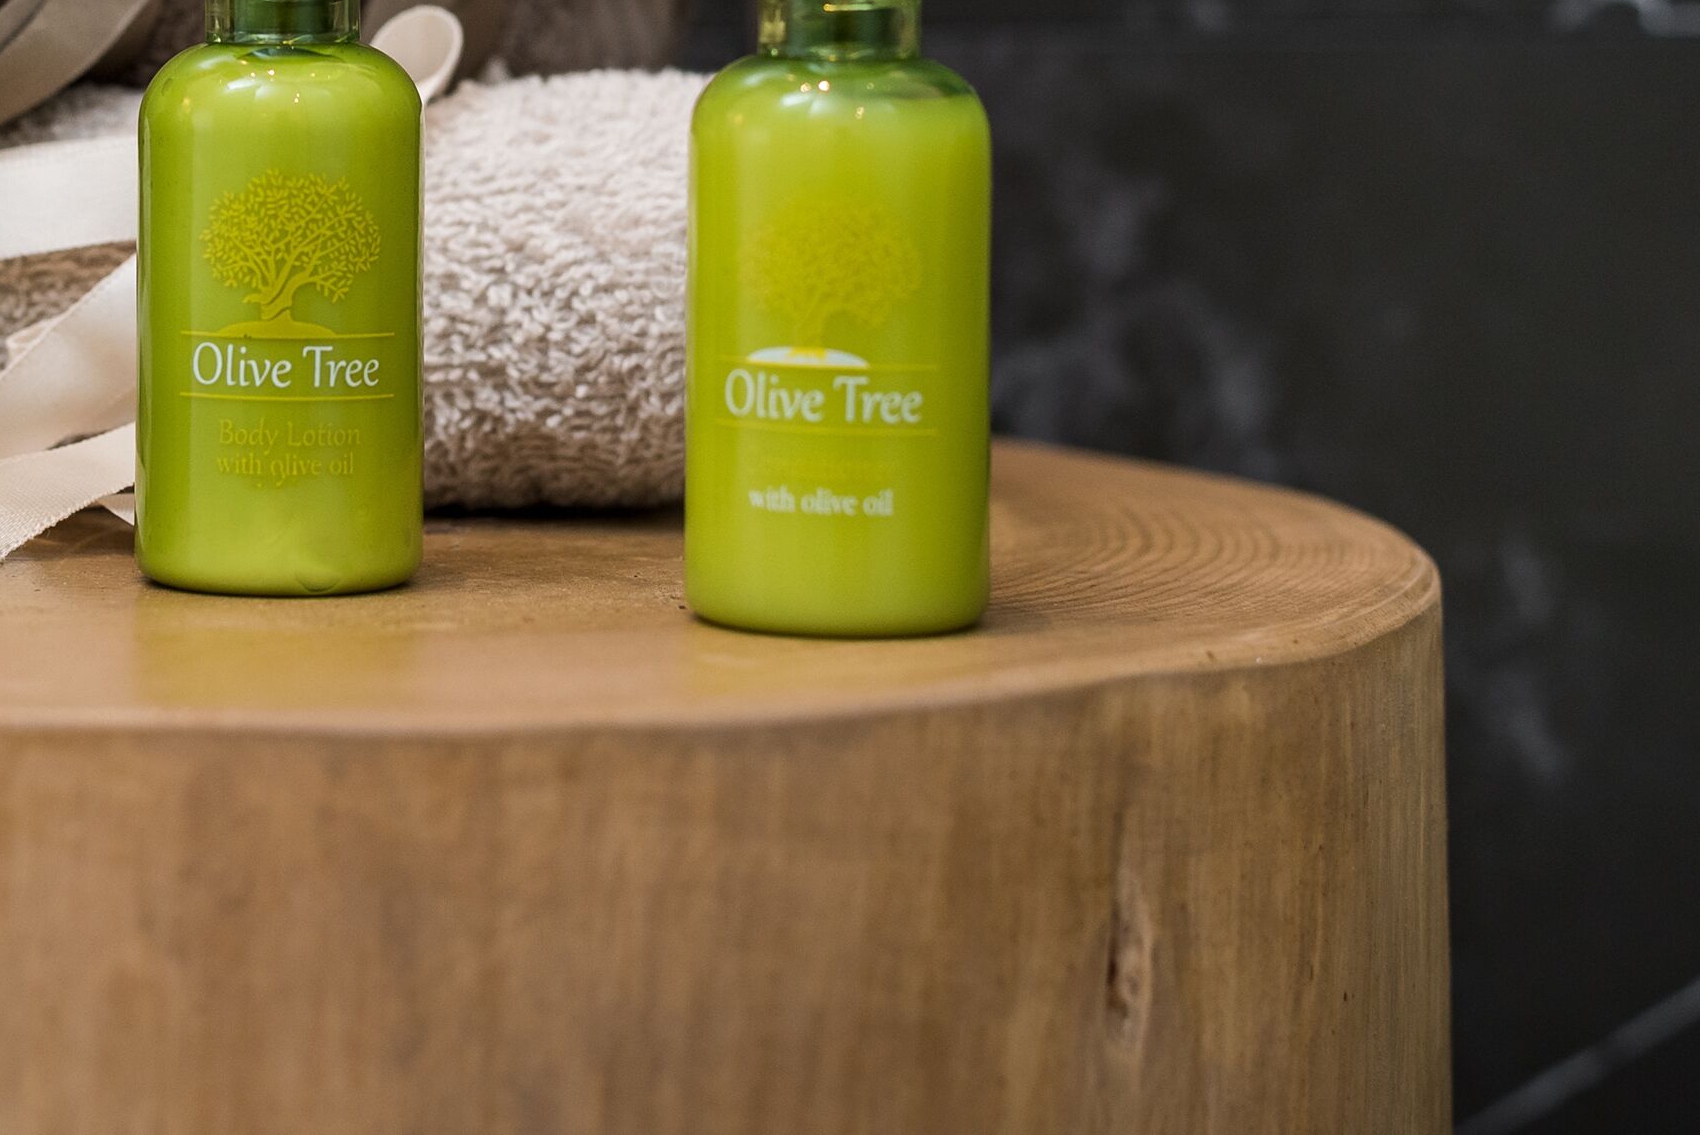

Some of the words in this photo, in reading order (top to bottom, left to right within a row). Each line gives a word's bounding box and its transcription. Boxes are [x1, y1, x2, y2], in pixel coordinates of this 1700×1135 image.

[193, 342, 292, 388] Olive
[302, 345, 380, 387] Tree
[724, 368, 825, 422] Olive
[833, 376, 922, 423] Tree
[219, 417, 279, 456] Body
[286, 421, 361, 447] Lotion
[217, 453, 262, 475] with
[328, 452, 355, 475] oil
[748, 486, 796, 514] with
[801, 488, 858, 517] olive
[862, 490, 894, 517] oil
